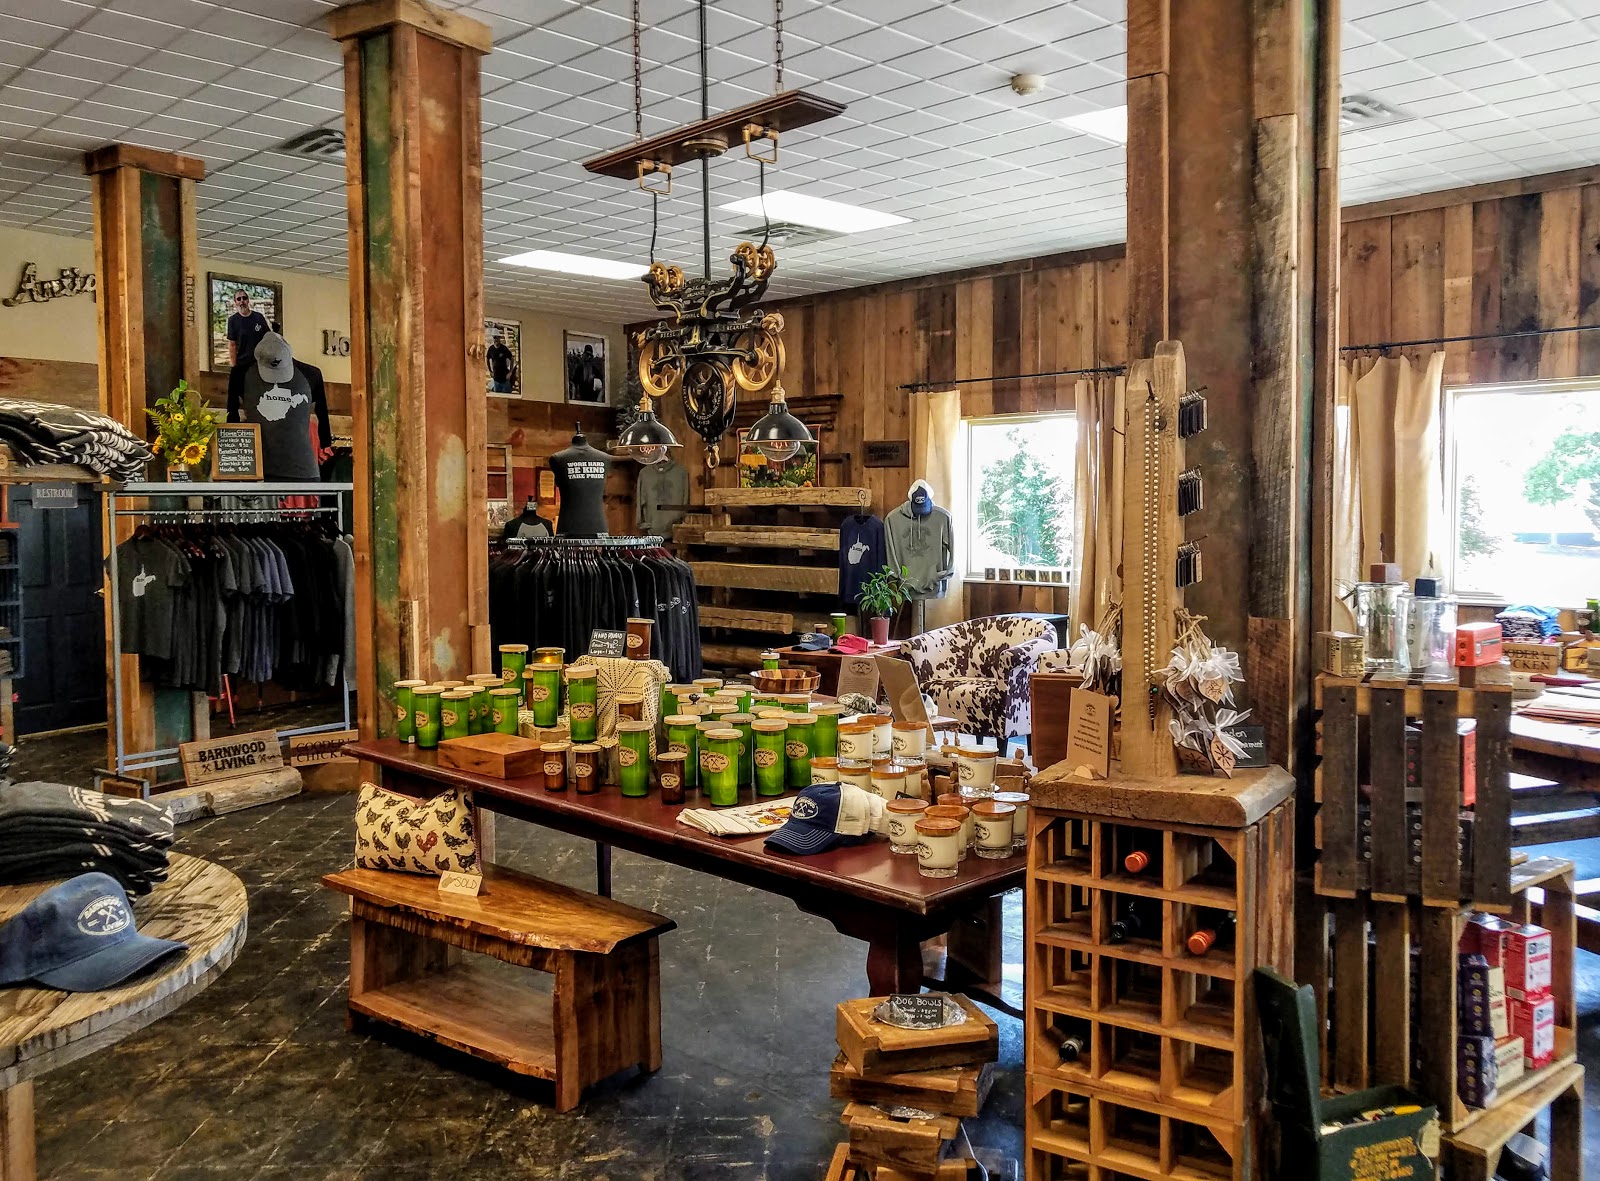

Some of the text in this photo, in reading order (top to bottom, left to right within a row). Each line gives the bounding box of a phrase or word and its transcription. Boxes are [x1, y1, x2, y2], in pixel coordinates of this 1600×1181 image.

[36, 488, 73, 498] RESTROOM
[198, 740, 266, 763] BARNWOOD
[214, 753, 257, 772] LIVING
[454, 876, 477, 890] SOLD
[895, 996, 942, 1008] DOG BOWLS
